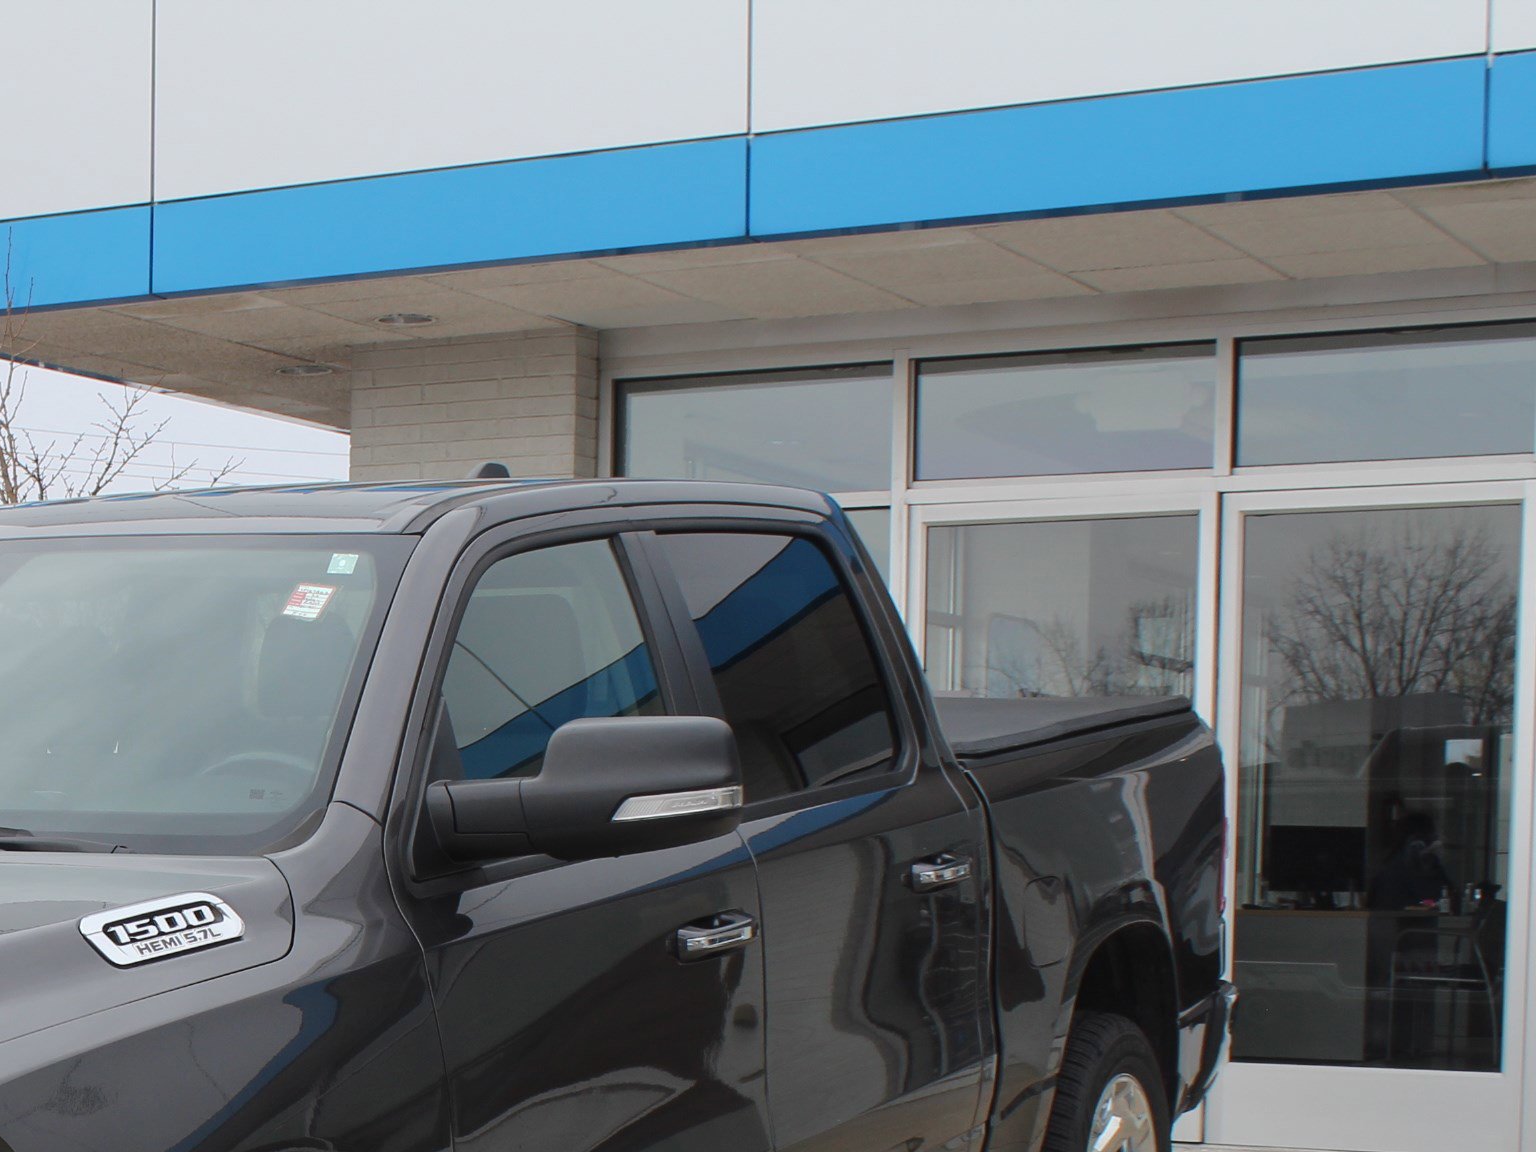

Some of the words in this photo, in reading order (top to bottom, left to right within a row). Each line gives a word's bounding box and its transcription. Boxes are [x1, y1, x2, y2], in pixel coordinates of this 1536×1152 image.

[106, 905, 215, 944] 1500
[136, 935, 182, 956] HEMI
[183, 927, 221, 944] 5.7L
